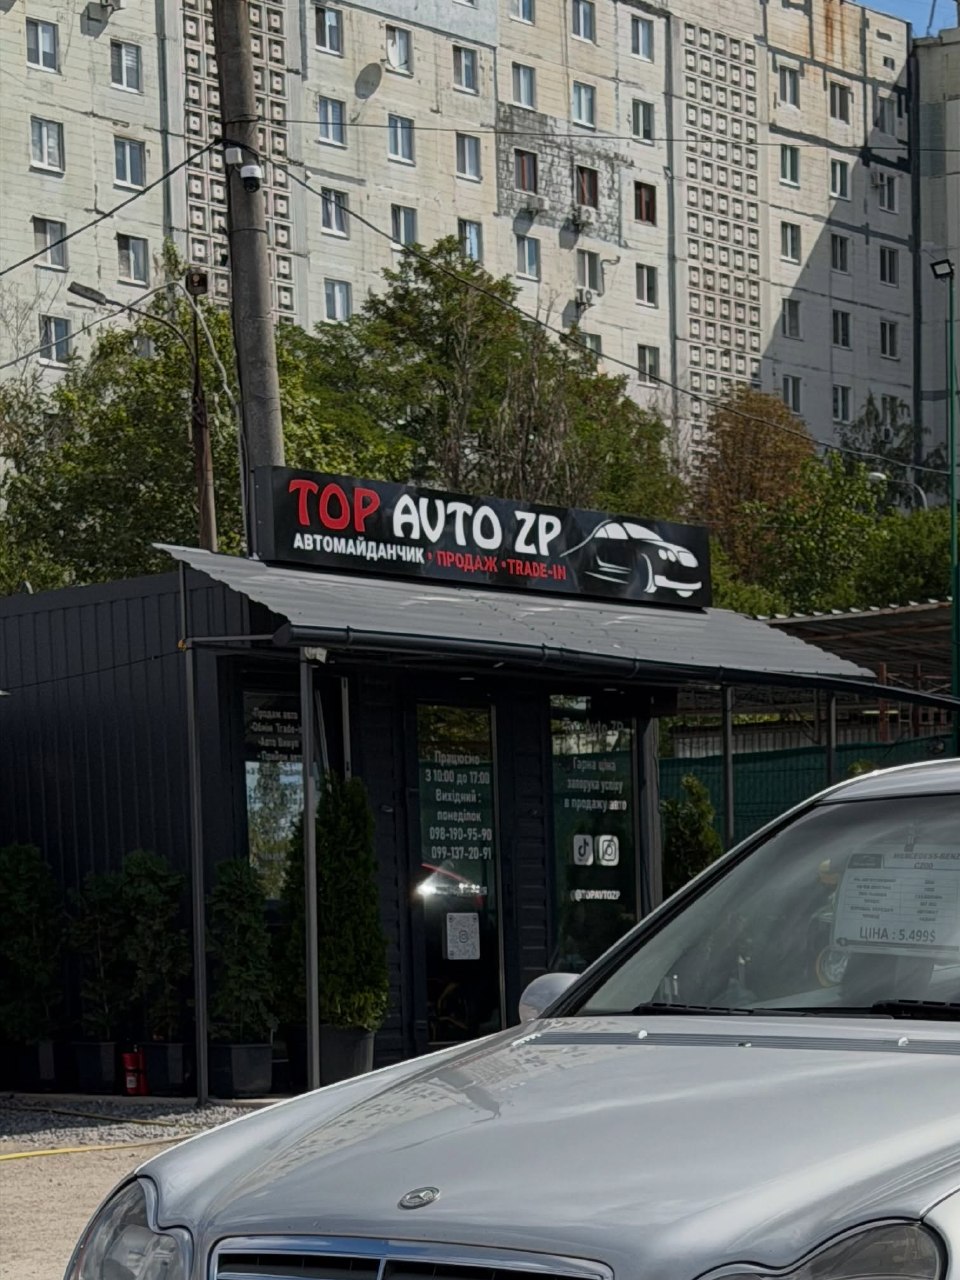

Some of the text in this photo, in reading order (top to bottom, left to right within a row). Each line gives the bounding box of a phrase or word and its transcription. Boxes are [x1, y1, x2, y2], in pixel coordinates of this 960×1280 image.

[288, 479, 380, 532] TOP
[514, 510, 562, 557] ZP
[293, 531, 567, 581] АВТОМАЙДАНЧИК ПРОДАЖ TRADE-IN
[433, 769, 454, 783] 10:00
[456, 774, 467, 785] до
[469, 771, 490, 784] 17:00
[609, 800, 628, 811] авто
[437, 808, 481, 823] понеділок
[860, 927, 889, 941] ЦІНА
[899, 929, 936, 943] 5.499$
